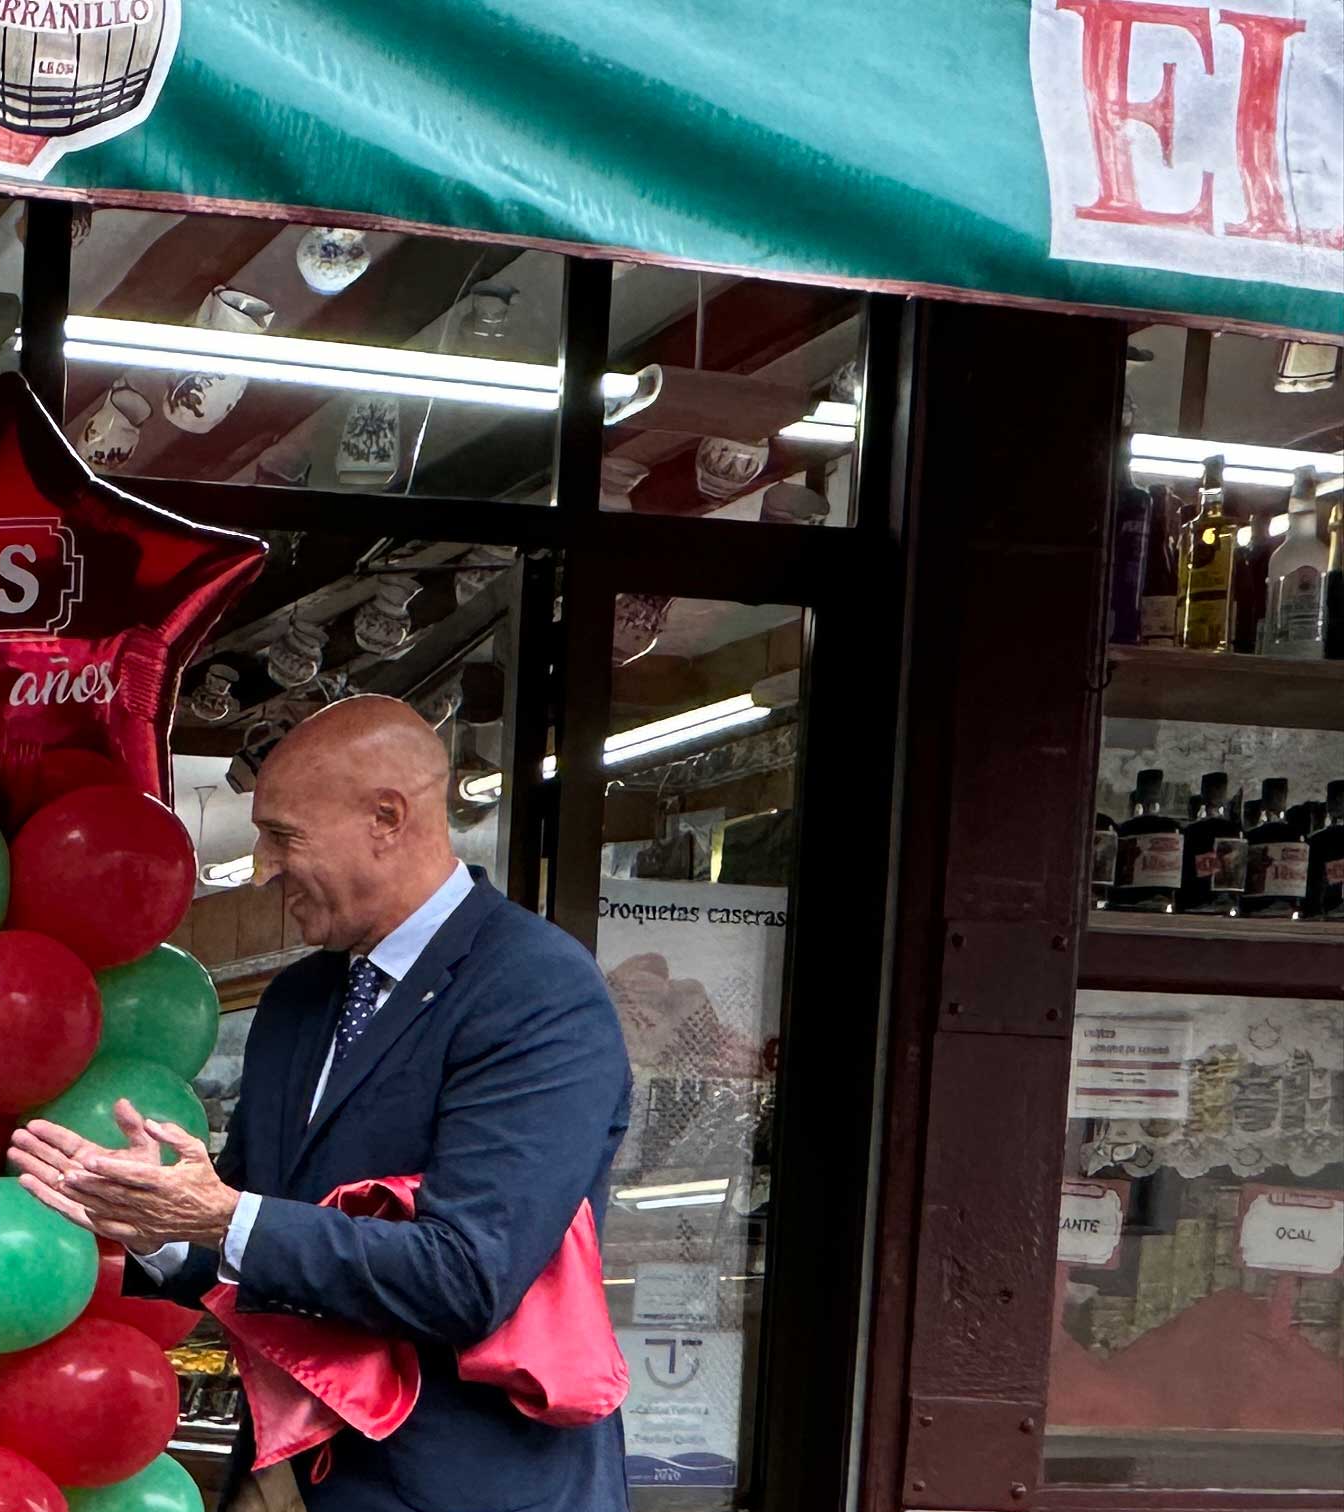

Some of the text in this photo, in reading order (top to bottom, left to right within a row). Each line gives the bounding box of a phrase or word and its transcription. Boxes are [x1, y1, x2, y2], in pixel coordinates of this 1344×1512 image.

[9, 657, 123, 705] años
[598, 897, 786, 926] Croquetas caseras
